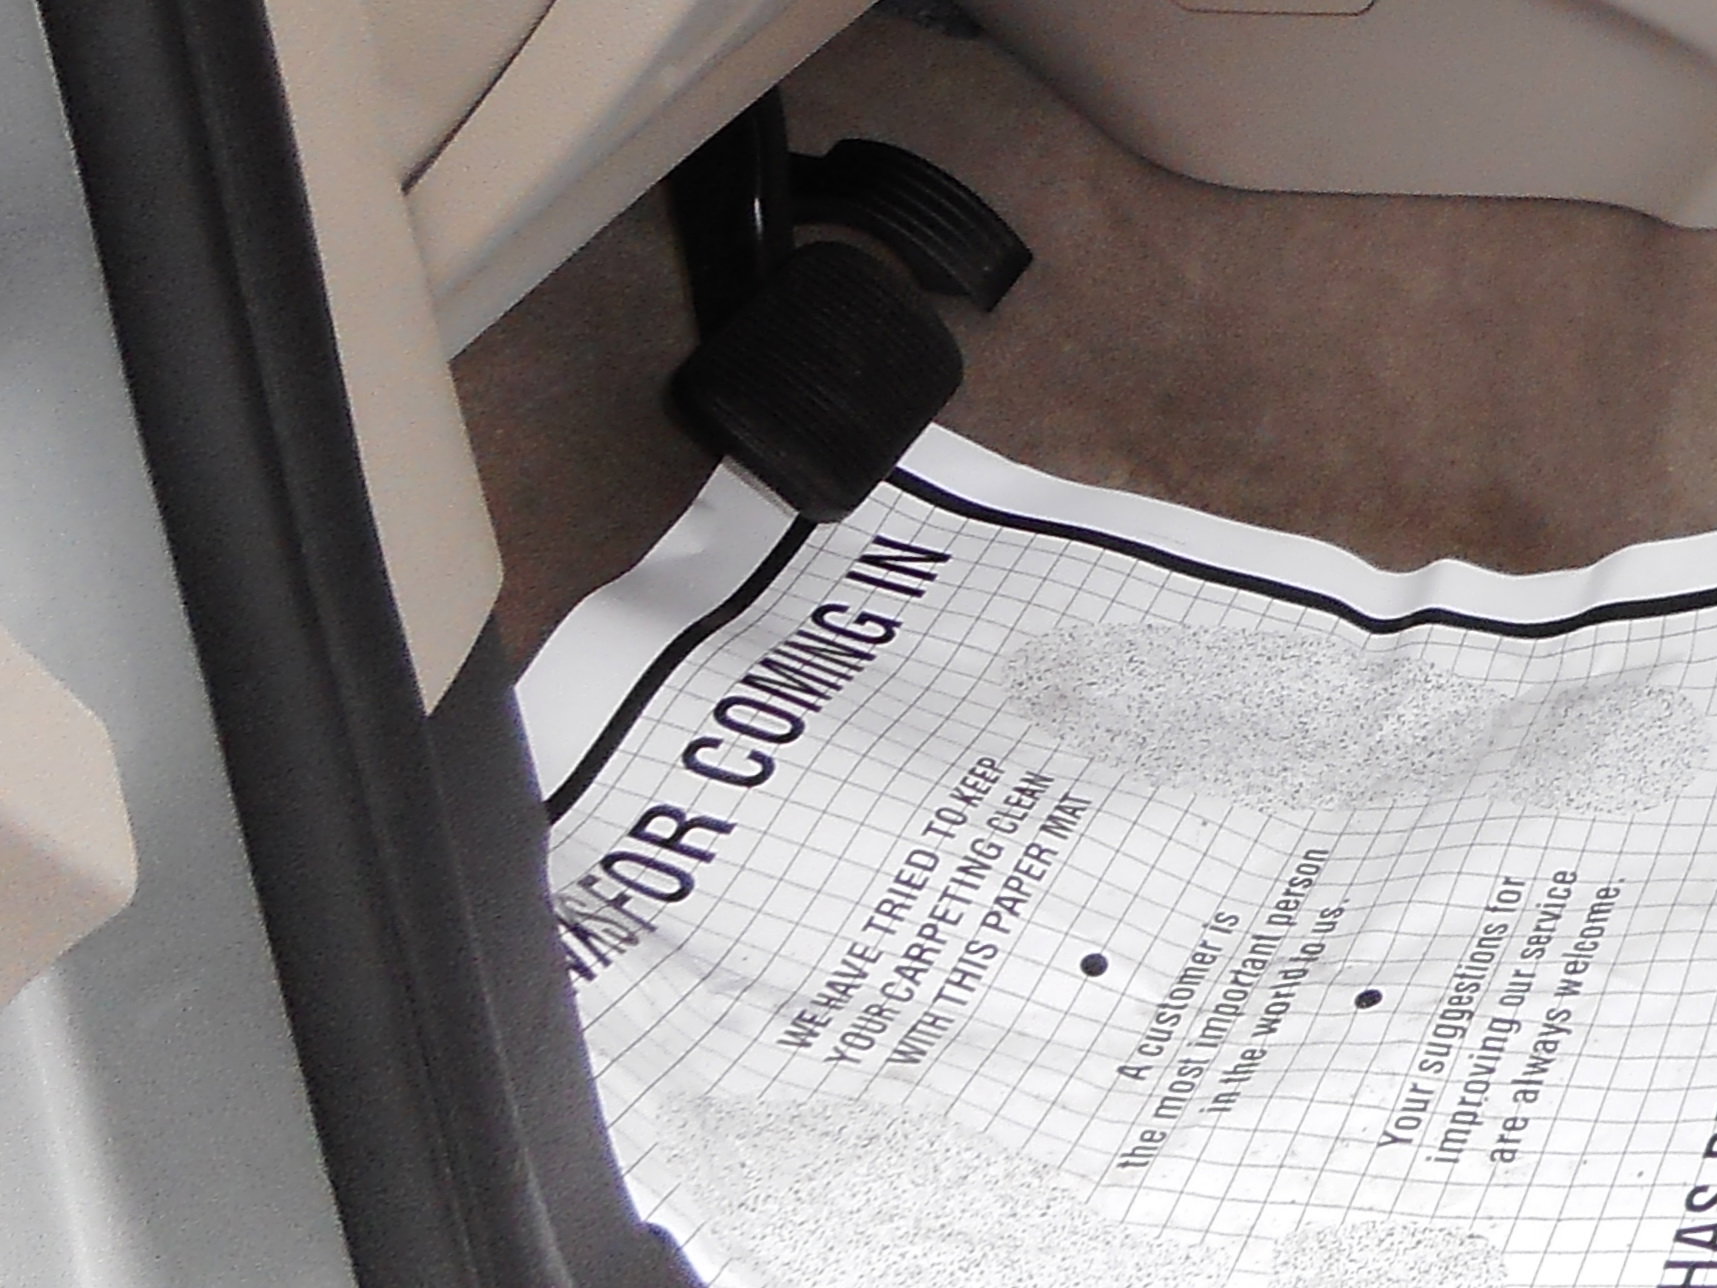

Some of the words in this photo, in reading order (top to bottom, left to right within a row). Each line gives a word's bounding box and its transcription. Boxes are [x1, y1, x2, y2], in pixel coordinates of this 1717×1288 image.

[578, 804, 738, 932] FOR
[682, 603, 903, 788] COMING
[846, 535, 951, 598] IN
[776, 1009, 832, 1049] WE
[812, 941, 884, 1011] HAVE
[862, 848, 940, 935] TRIED
[922, 807, 968, 838] TO
[949, 756, 1005, 808] KEEP
[823, 1003, 900, 1064] YOUR
[880, 838, 1005, 1003] CARPETING
[986, 770, 1055, 834] CLEAN
[885, 1012, 955, 1066] WITH
[933, 940, 999, 1006] THIS
[982, 842, 1059, 935] PAPER
[1039, 792, 1093, 840] MAT
[1116, 1064, 1154, 1081] A
[1137, 939, 1224, 1056] customer
[1201, 911, 1240, 934] is
[1116, 1129, 1167, 1169] the
[1152, 1057, 1210, 1120] most
[1187, 934, 1282, 1048] important
[1265, 847, 1330, 926] person
[1251, 968, 1309, 1038] world
[1289, 942, 1326, 963] to
[1312, 898, 1350, 934] us.
[1376, 1082, 1435, 1148] Your
[1418, 923, 1510, 1074] suggestions
[1485, 876, 1525, 913] for
[1425, 1017, 1522, 1164] improving
[1500, 969, 1536, 1007] our
[1520, 870, 1577, 960] service
[1489, 1116, 1529, 1163] are
[1511, 1008, 1573, 1104] always
[1554, 878, 1626, 998] welcome.
[1199, 1091, 1241, 1114] in
[1219, 1048, 1267, 1085] the
